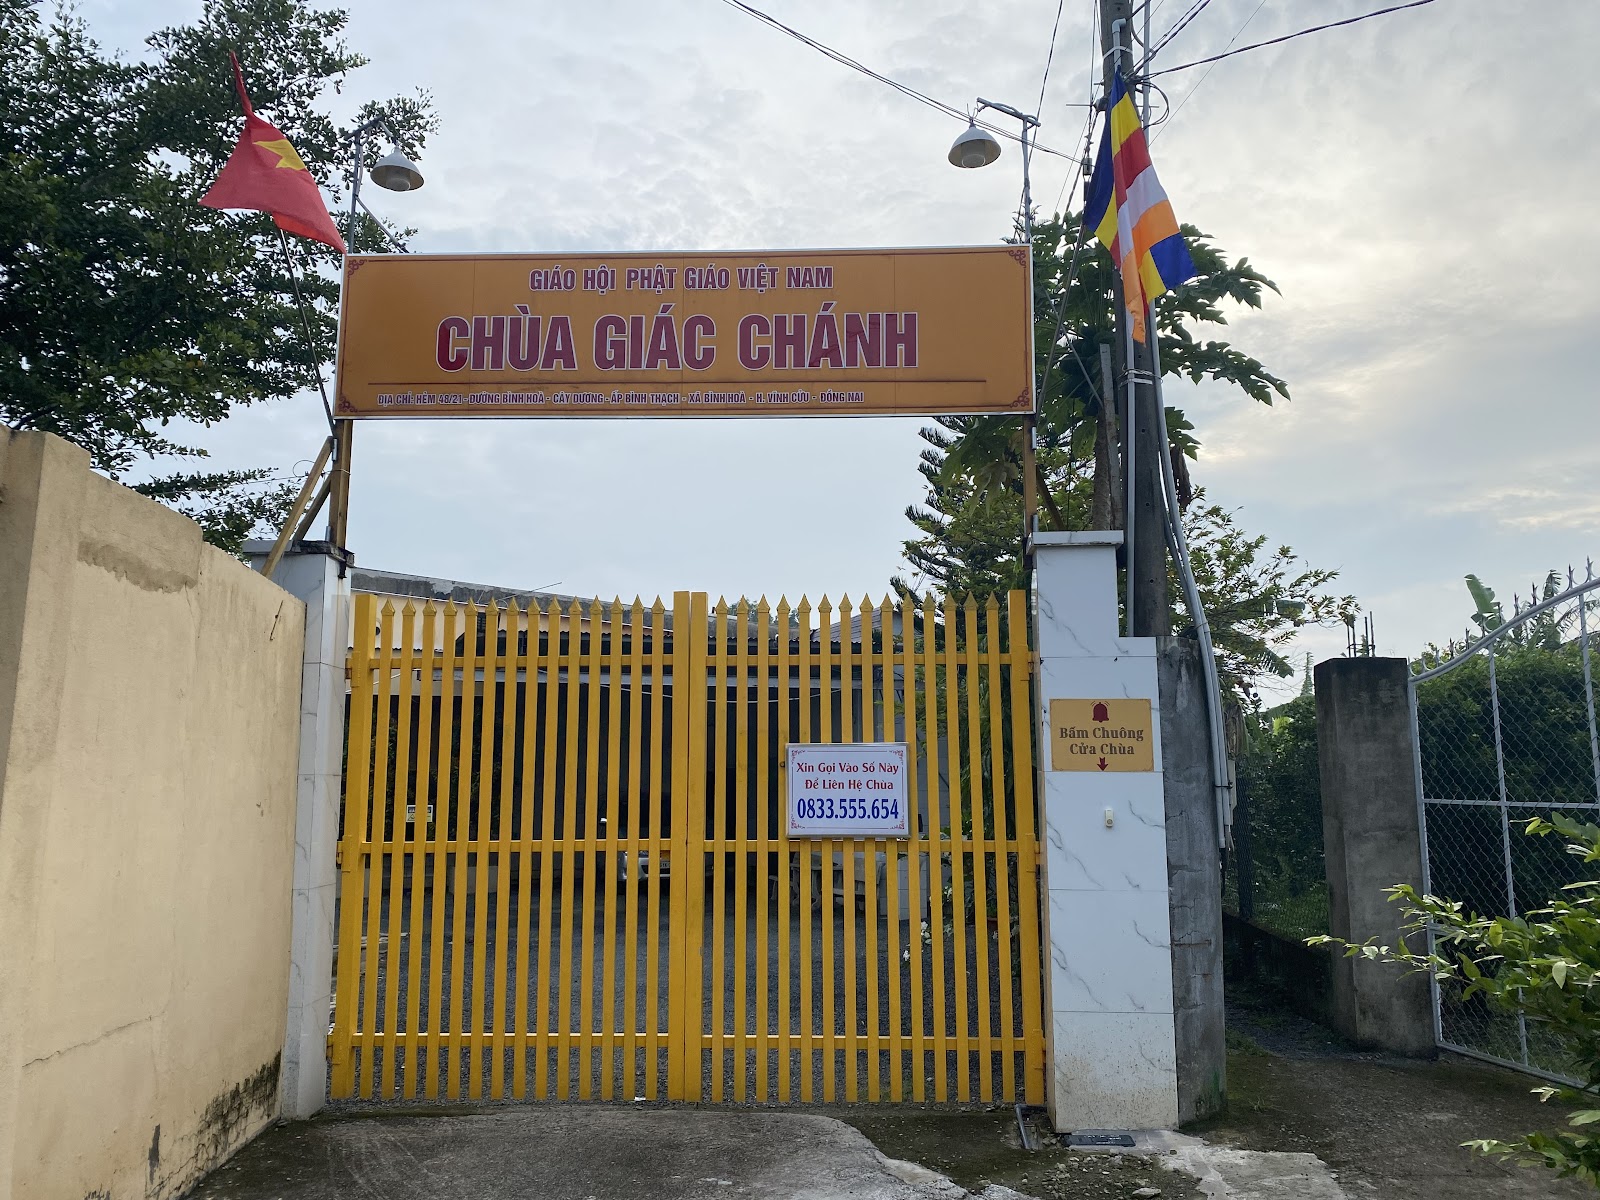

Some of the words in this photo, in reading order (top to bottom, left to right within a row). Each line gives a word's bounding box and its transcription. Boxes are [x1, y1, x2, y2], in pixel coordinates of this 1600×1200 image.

[529, 264, 577, 291] GIÁO
[582, 264, 616, 295] HỘI
[626, 264, 677, 294] PHẬT
[684, 263, 731, 290] GIÁO
[737, 262, 780, 294] VIỆT
[786, 266, 834, 289] NAM
[436, 303, 578, 372] CHÙA
[592, 302, 717, 371] GIÁC
[737, 300, 919, 371] CHÁNH
[378, 393, 394, 407] ĐỊA
[438, 394, 462, 404] 48/21
[502, 390, 524, 404] BÌNH
[526, 390, 545, 404] HOÀ
[553, 390, 571, 404] CÂY
[572, 392, 604, 404] DƯƠNG
[610, 389, 623, 404] ẤP
[625, 390, 648, 404] BÌNH
[650, 392, 680, 406] THẠCH
[688, 390, 702, 404] XÃ
[703, 390, 726, 403] BÌNH
[727, 390, 746, 403] HOÀ
[756, 392, 765, 403] H.
[767, 390, 789, 403] VĨNH
[847, 391, 865, 402] NAI
[1059, 726, 1089, 739] Bấm
[1092, 727, 1144, 741] Chuông
[1069, 742, 1097, 755] Cửa
[1100, 743, 1135, 755] Chùa
[796, 762, 814, 773] Xin
[818, 762, 836, 775] Gọi
[839, 762, 859, 773] Vào
[862, 761, 875, 773] Số
[879, 762, 899, 775] Này
[805, 777, 819, 790] Để
[822, 779, 845, 790] Liên
[848, 779, 863, 792] Hệ
[866, 779, 894, 790] Chùa
[797, 798, 899, 820] 0833.555.654
